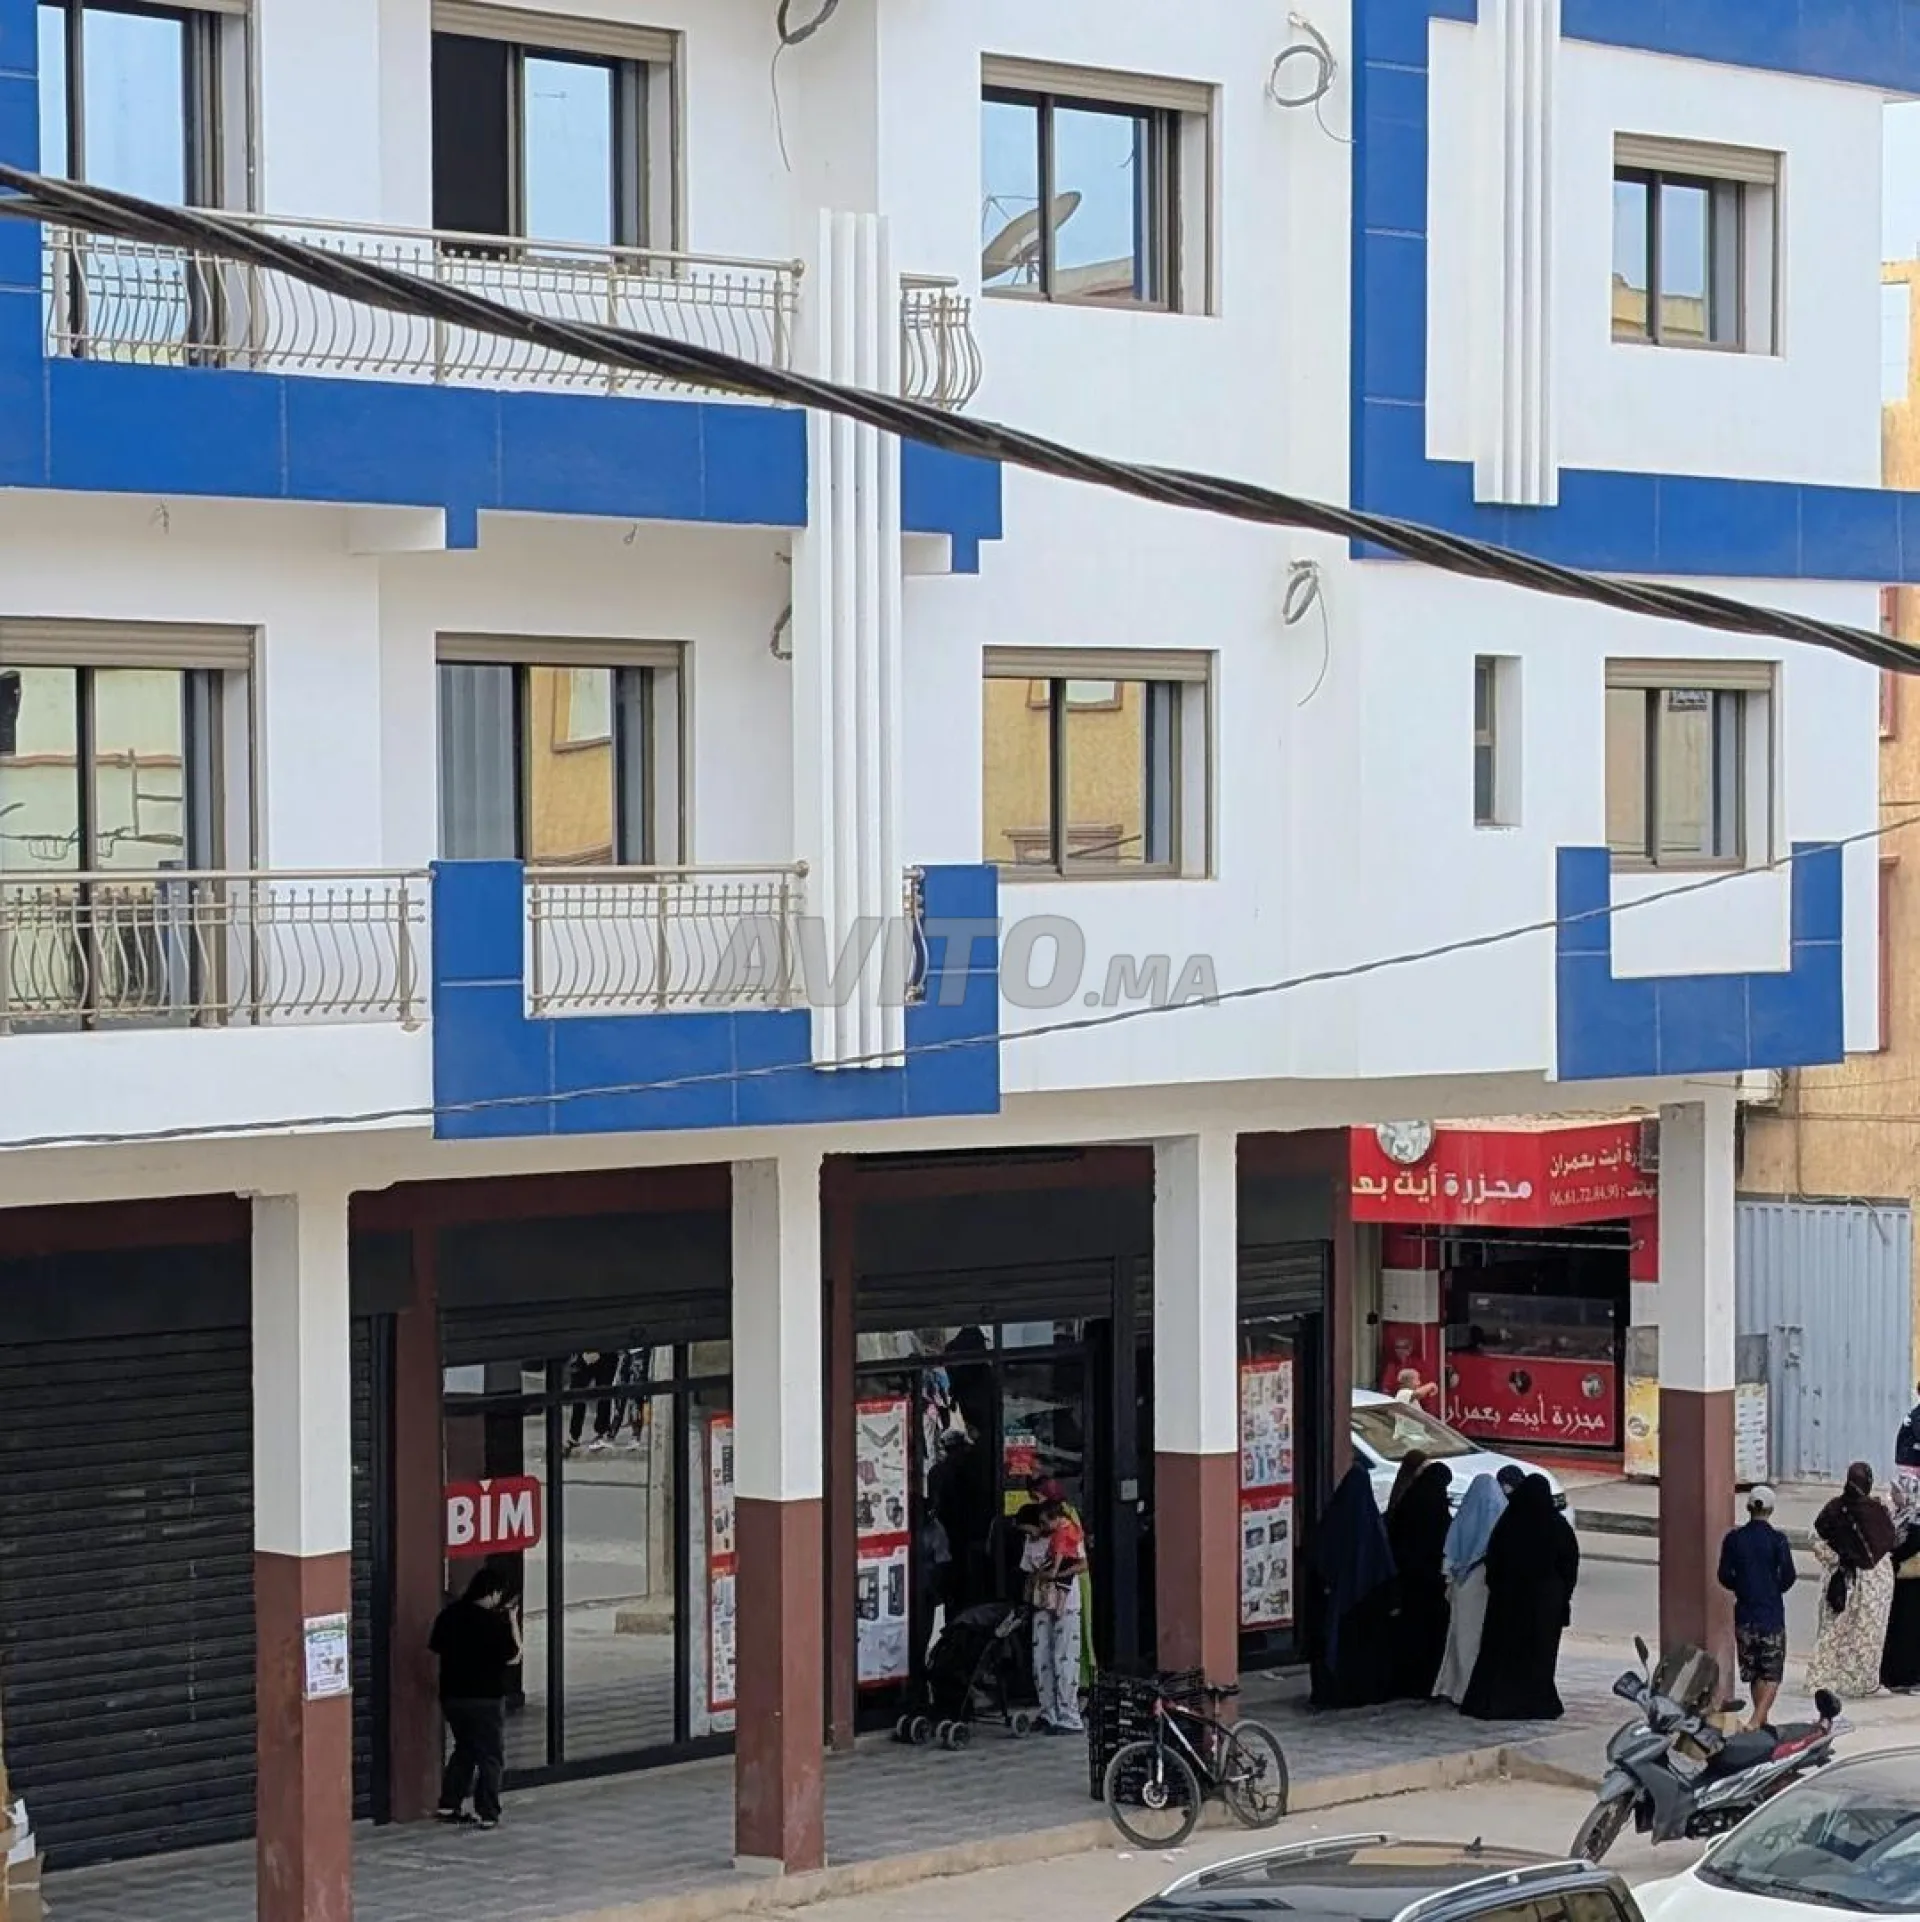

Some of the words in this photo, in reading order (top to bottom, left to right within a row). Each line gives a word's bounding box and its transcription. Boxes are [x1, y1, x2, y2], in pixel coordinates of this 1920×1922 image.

[1394, 1163, 1438, 1202] أيت
[1444, 1172, 1533, 1205] مجزرة
[1508, 1391, 1548, 1432] أيت
[1552, 1405, 1606, 1437] مجزرة
